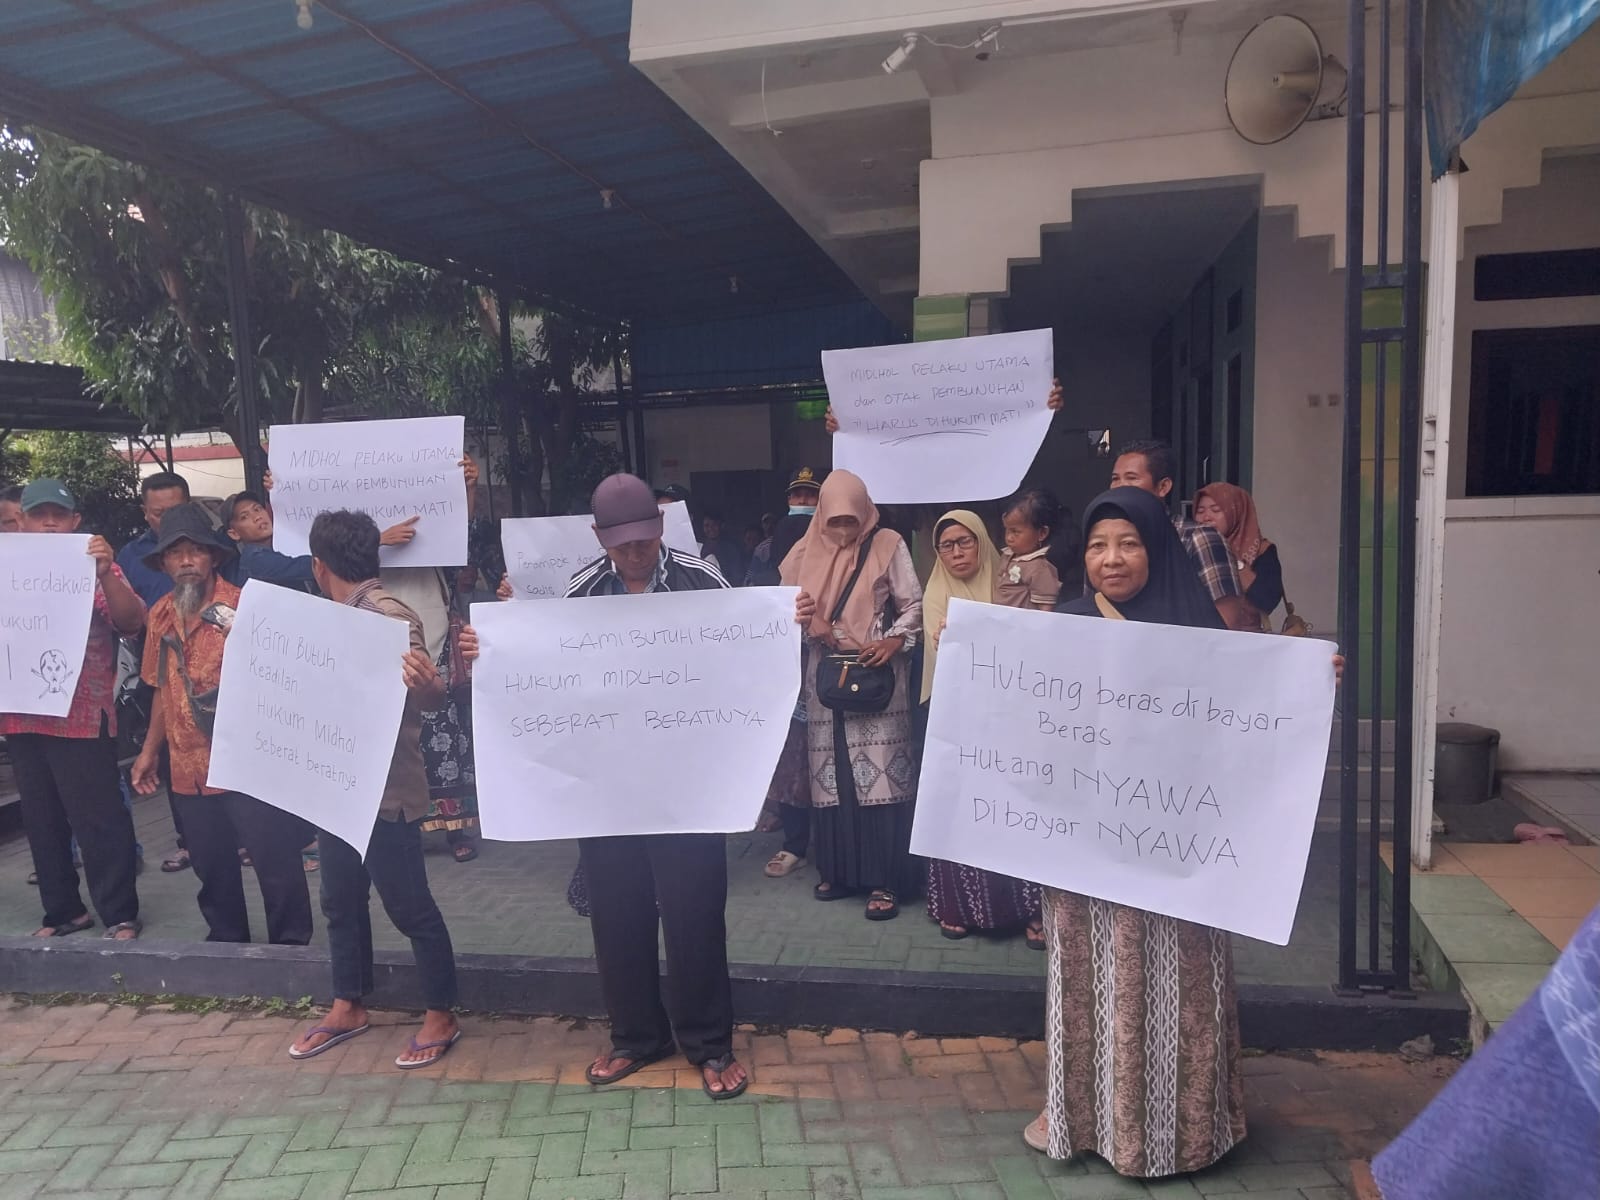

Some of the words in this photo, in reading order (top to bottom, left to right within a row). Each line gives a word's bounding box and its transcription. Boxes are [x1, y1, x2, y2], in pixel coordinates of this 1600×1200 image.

[911, 361, 967, 376] PELAKU
[976, 356, 1029, 371] UTAMA
[932, 379, 1024, 400] PEMBUNUHAN
[290, 451, 342, 468] MIDHOL
[412, 446, 456, 463] UTAMA
[308, 478, 350, 492] OTAK
[356, 473, 447, 490] PEMBUNUHAN
[413, 500, 454, 517] MATI
[11, 570, 92, 594] terdakwa
[559, 631, 624, 652] KAMI
[629, 626, 693, 648] BUTUH
[700, 618, 788, 643] KEADILAN
[505, 672, 582, 694] HUKUM
[971, 642, 1083, 711] Hutang
[1096, 675, 1163, 715] beras
[1207, 697, 1293, 732] bayar
[511, 712, 620, 738] SEBERAT
[644, 708, 766, 730] BERATNYA
[1038, 710, 1112, 746] Beras
[959, 745, 1054, 784] Hutang
[1073, 767, 1222, 818] NYAWA
[1005, 801, 1081, 838] bayar
[1098, 820, 1239, 868] NYAWA
